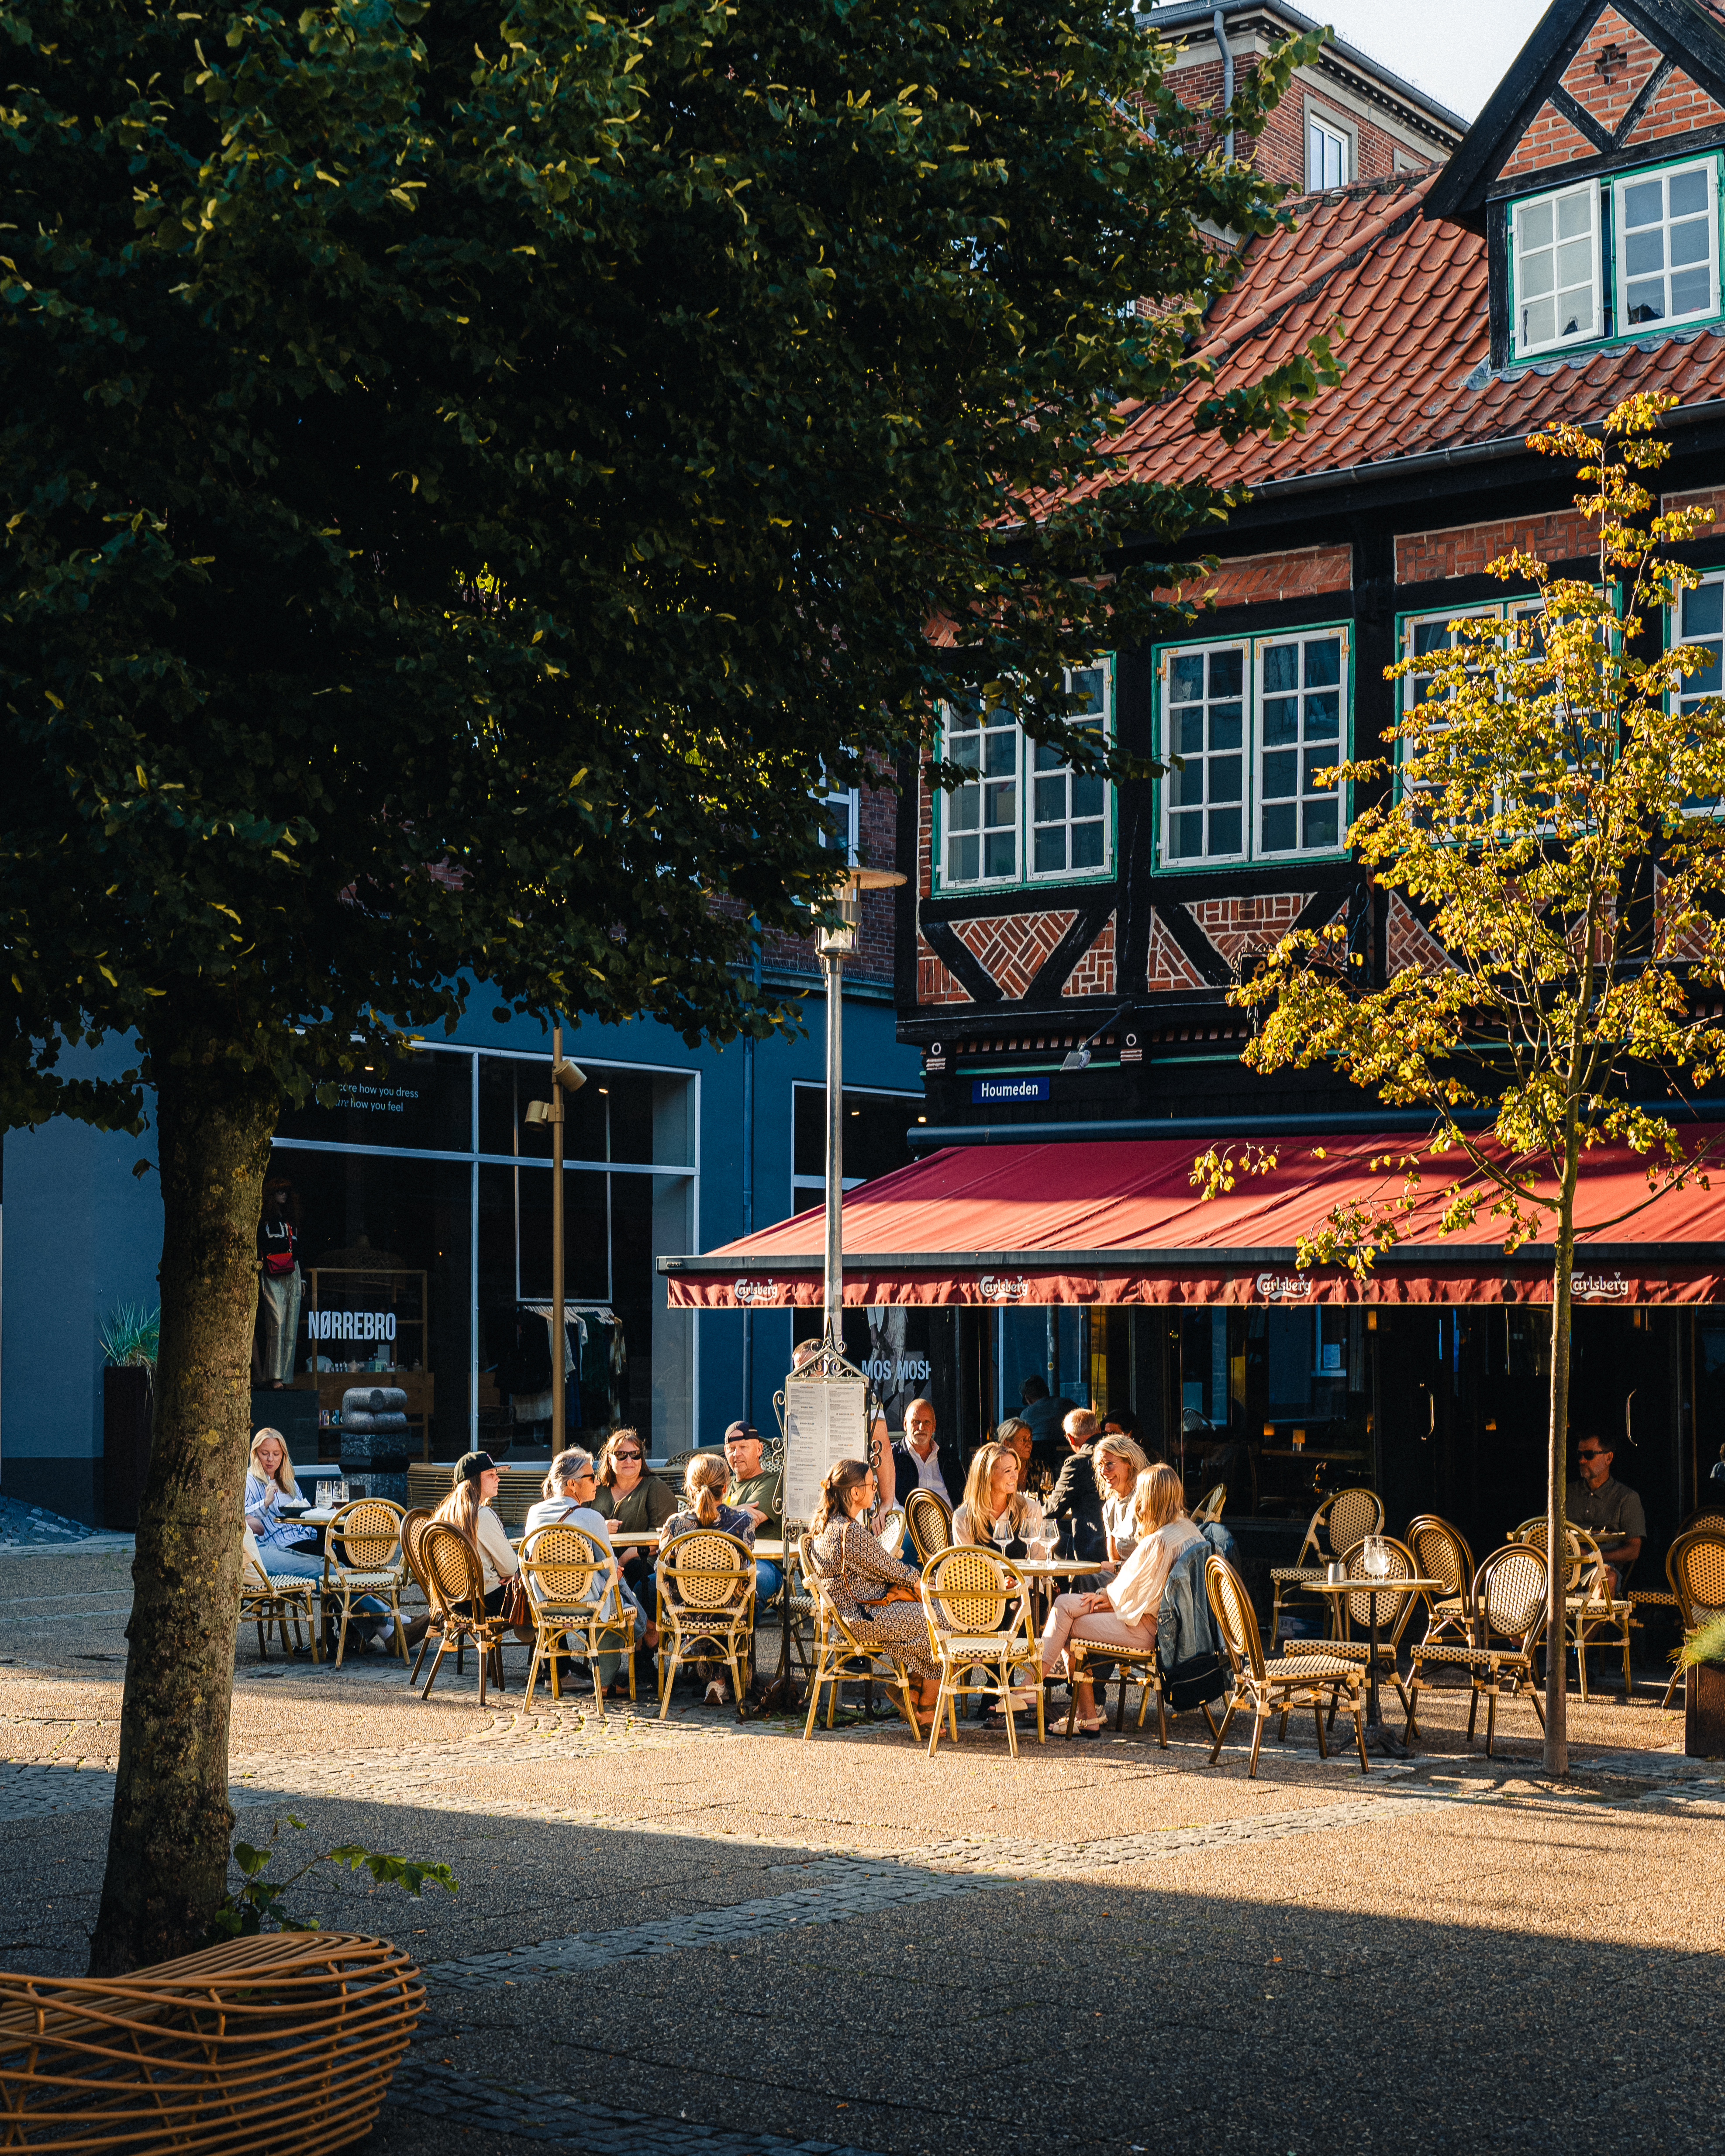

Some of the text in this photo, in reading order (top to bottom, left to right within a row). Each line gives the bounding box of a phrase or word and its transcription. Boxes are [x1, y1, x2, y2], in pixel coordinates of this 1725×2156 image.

[359, 1083, 377, 1094] how
[379, 1088, 394, 1097] you
[396, 1087, 418, 1098] dress
[981, 1081, 1038, 1097] Houmeden
[351, 1098, 369, 1109] how
[371, 1102, 385, 1112] you
[388, 1101, 403, 1112] feel
[734, 1279, 777, 1303] Carlsberg
[980, 1275, 1028, 1301] Carlsberg
[1256, 1273, 1311, 1301] Carlsberg
[1570, 1271, 1628, 1301] Carlsberg
[308, 1311, 396, 1340] NØRREBRO
[862, 1360, 891, 1380] MOS
